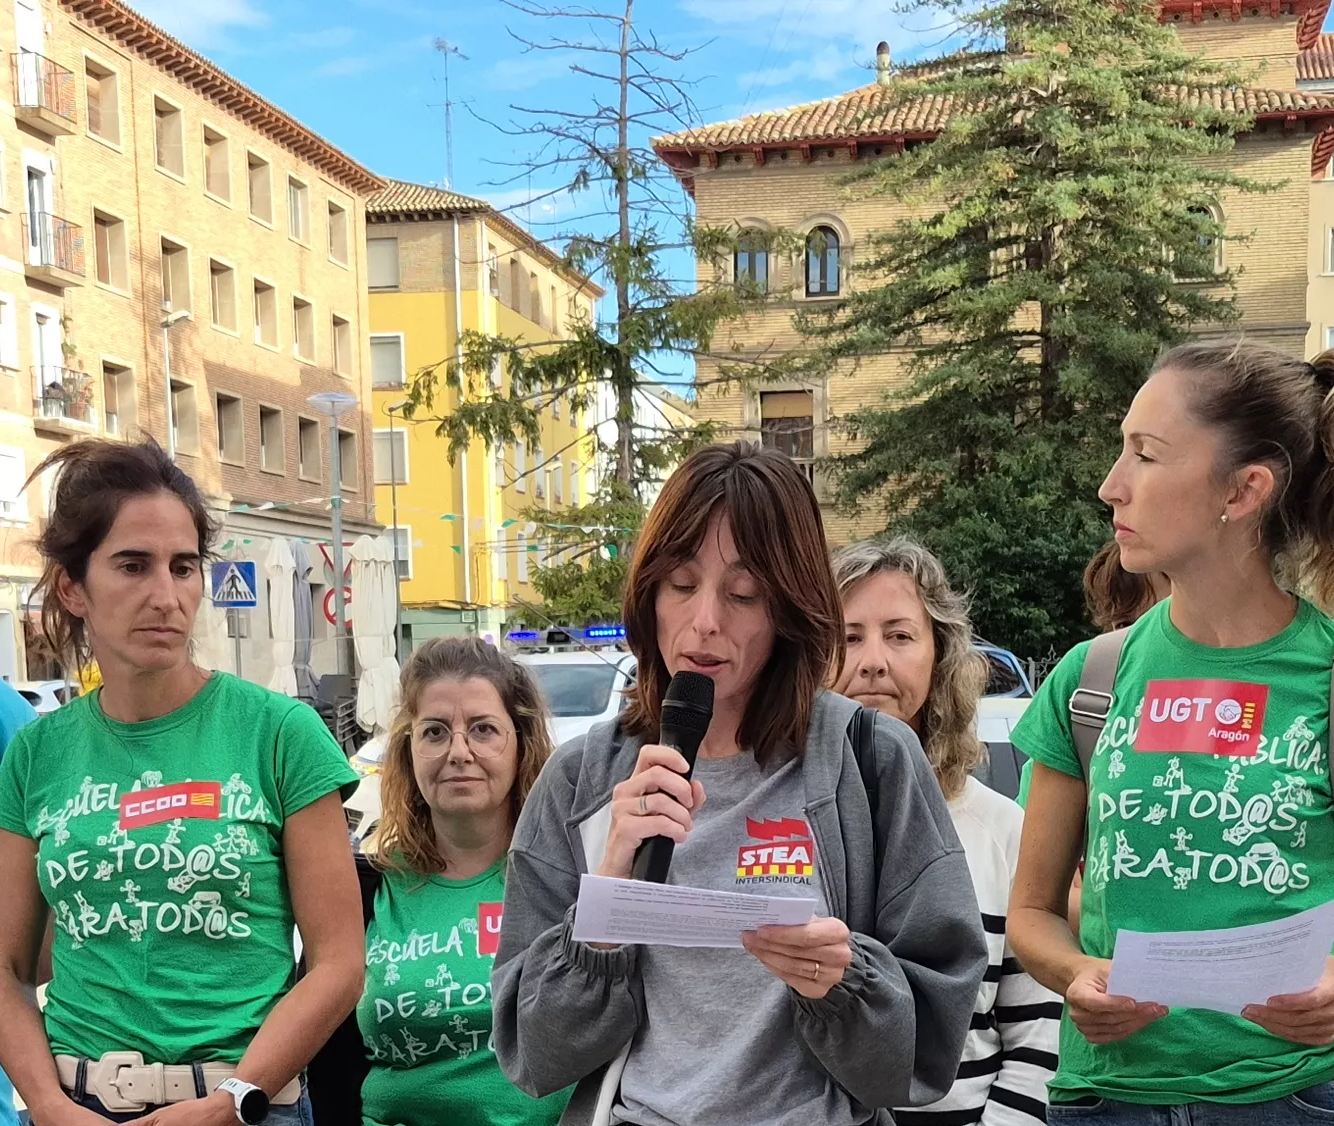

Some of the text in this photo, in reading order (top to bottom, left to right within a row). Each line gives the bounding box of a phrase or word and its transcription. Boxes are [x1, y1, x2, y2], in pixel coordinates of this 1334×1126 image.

[1148, 696, 1213, 723] UGT
[1207, 727, 1250, 742] Aragón
[125, 793, 187, 818] CCOO
[1098, 788, 1299, 832] DE TOD@S
[45, 842, 242, 889] DE TOD@S
[741, 846, 811, 866] STEA
[1089, 847, 1310, 895] PARA TOD@S
[735, 875, 813, 886] INTERSINDICAL
[134, 900, 252, 939] TOD@S
[366, 925, 465, 966] ESCUELA
[375, 991, 417, 1024] DE
